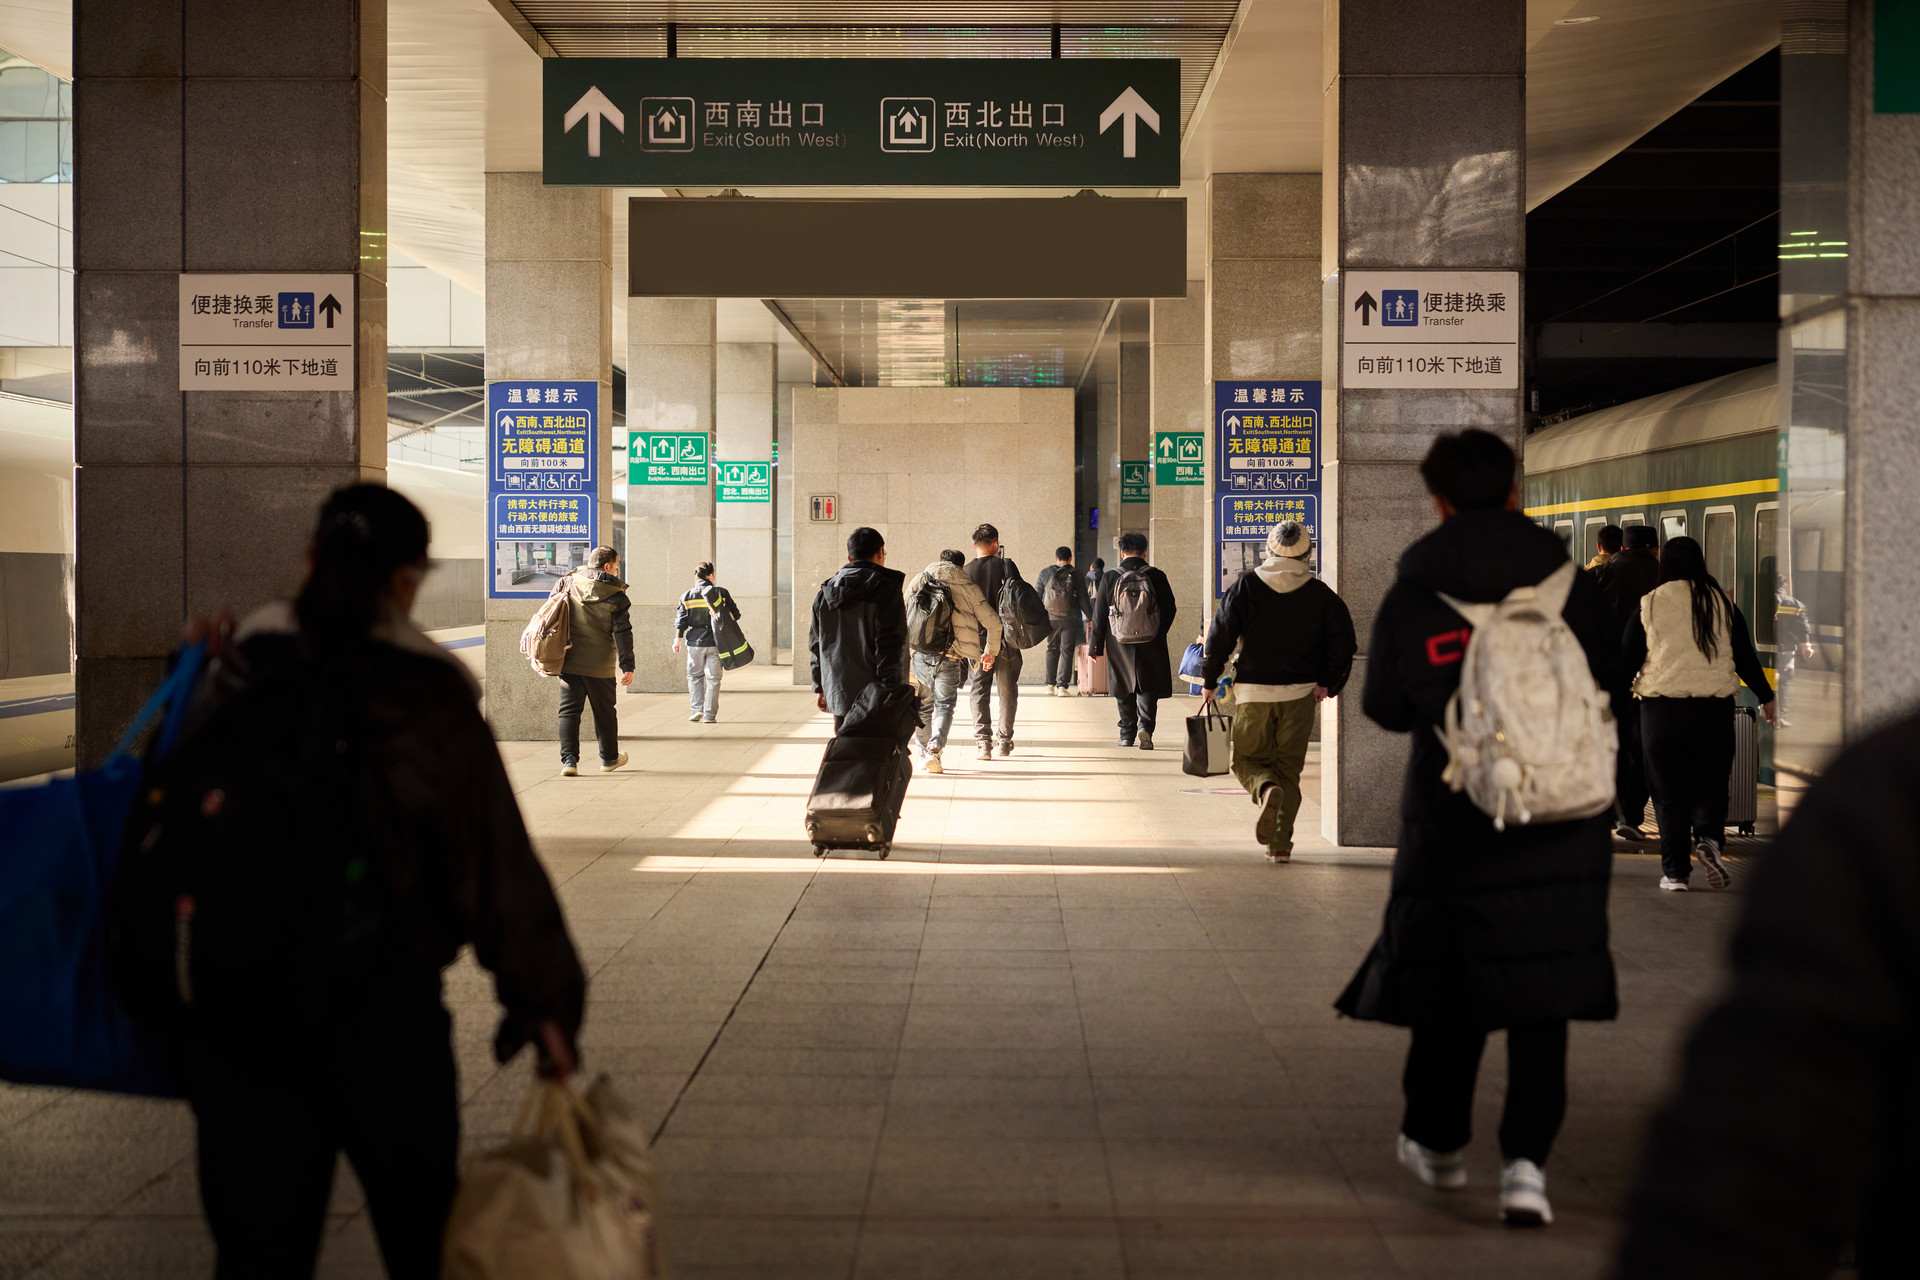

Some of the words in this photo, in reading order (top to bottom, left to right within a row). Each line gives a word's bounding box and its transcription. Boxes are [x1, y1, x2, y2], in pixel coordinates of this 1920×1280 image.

[704, 100, 823, 128] 西南出口
[944, 100, 1064, 128] 西北出口
[704, 132, 790, 149] Exit(South
[944, 132, 1028, 149] Exit(North
[1036, 132, 1085, 149] West)
[192, 294, 274, 315] 便捷换乘
[1423, 292, 1506, 312] 便捷换乘
[233, 319, 274, 328] Transfer
[1423, 316, 1464, 326] Transfer
[195, 358, 338, 377] 向前110米下地道
[1358, 356, 1503, 374] 向前110米下地道
[508, 388, 578, 403] 温馨提示
[1234, 388, 1304, 403] 温馨提示
[516, 415, 586, 428] 西南、西北出口
[1242, 415, 1312, 428] 西南、西北出口
[502, 438, 585, 454] 无障碍通道
[1228, 438, 1312, 454] 无障碍通道
[521, 459, 568, 468] 向前100米
[1247, 459, 1295, 468] 向前100米
[507, 499, 579, 510] 携带大件行李或
[1234, 500, 1305, 510] 携带大件行李或
[507, 512, 579, 522] 行动不便的旅客
